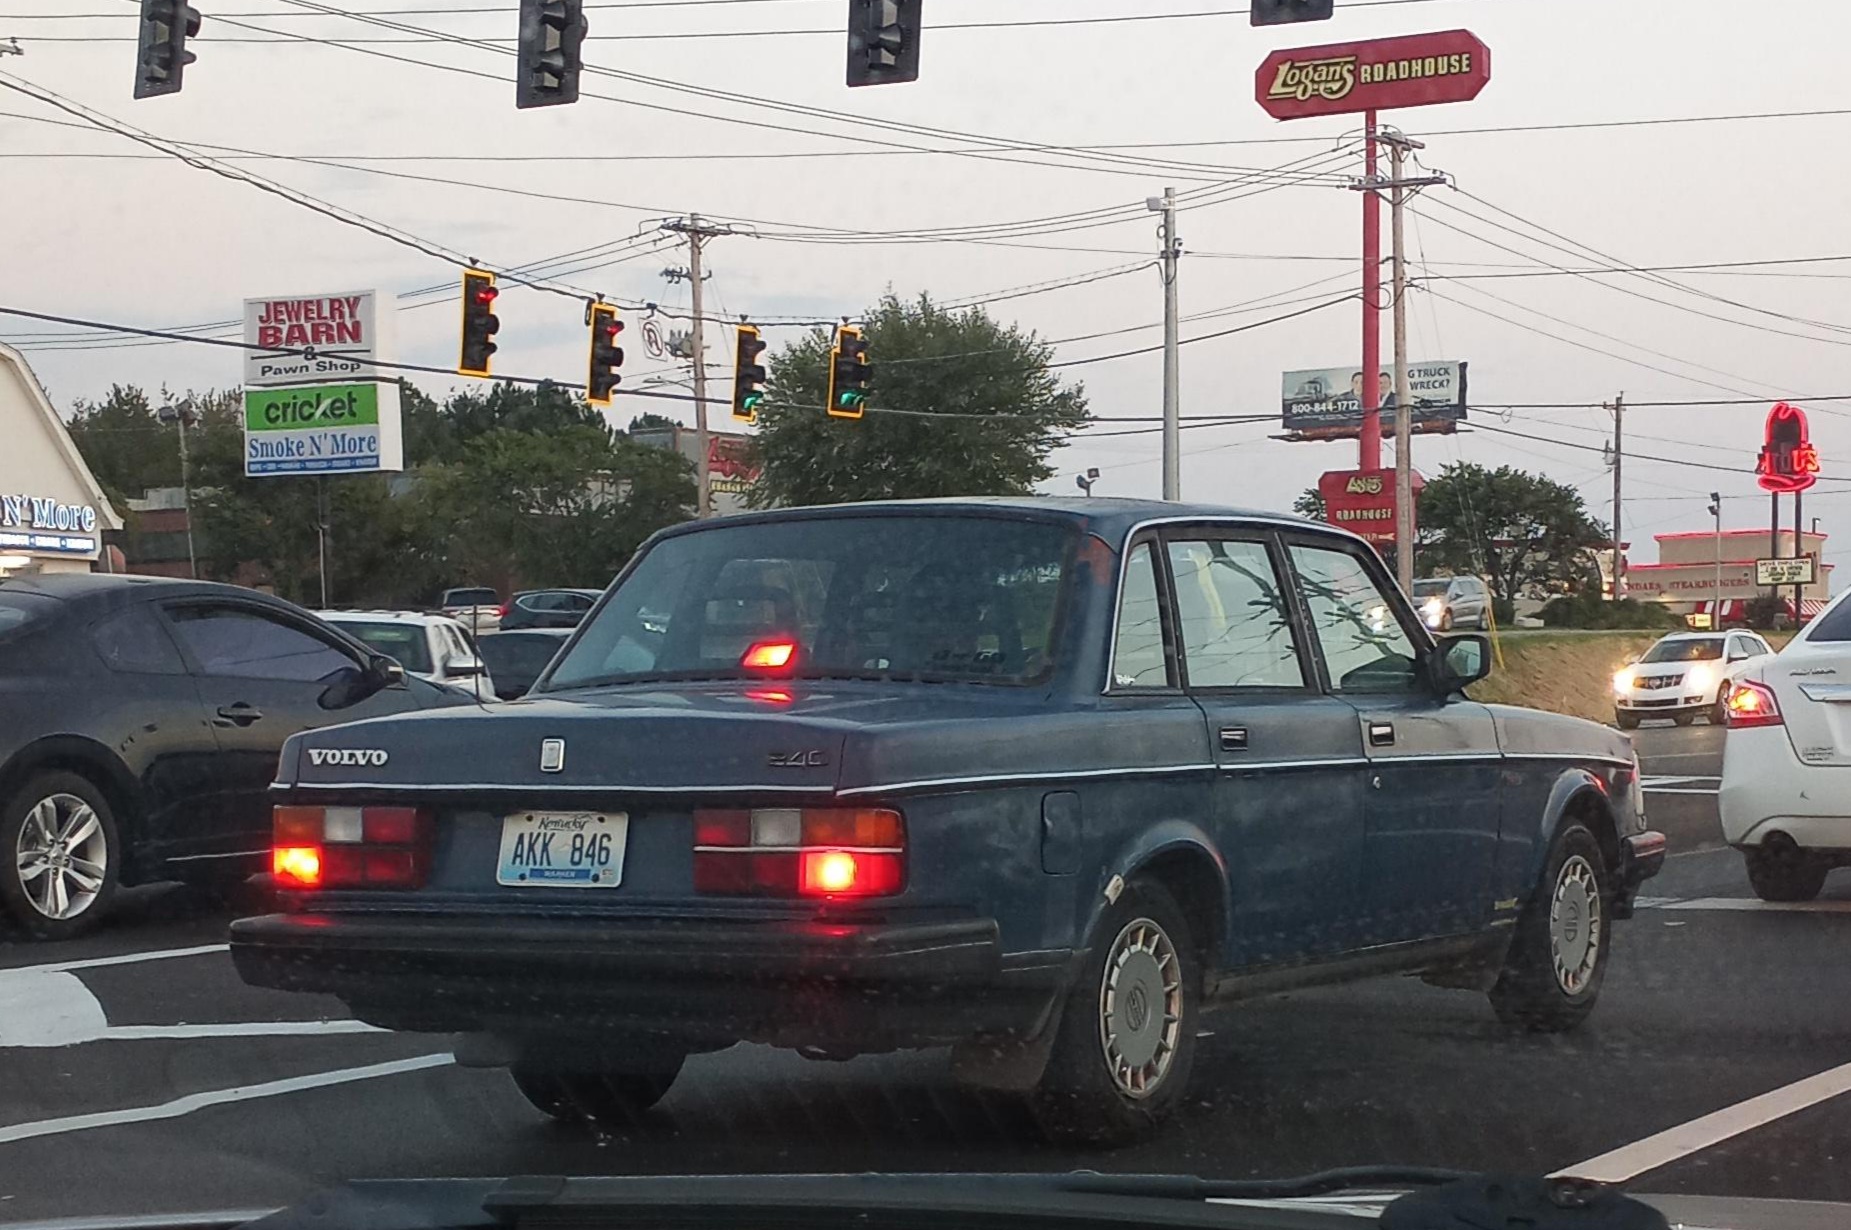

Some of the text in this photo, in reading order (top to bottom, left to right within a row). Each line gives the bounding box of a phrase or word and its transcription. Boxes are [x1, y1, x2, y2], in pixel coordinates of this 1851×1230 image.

[1266, 53, 1471, 100] Logan's ROADHOUSE
[258, 297, 361, 324] JEWELRY
[258, 321, 362, 347] BARN
[303, 346, 318, 361] &
[261, 360, 361, 376] Pawn Shop
[1418, 367, 1450, 378] TRUCK
[1409, 380, 1450, 391] WRECK?
[264, 391, 357, 424] cricket
[249, 432, 376, 458] Smoke N' More
[1, 494, 96, 532] N' More
[308, 748, 389, 766] VOLVO
[537, 816, 590, 831] Kentucky
[511, 831, 613, 867] AKK 846
